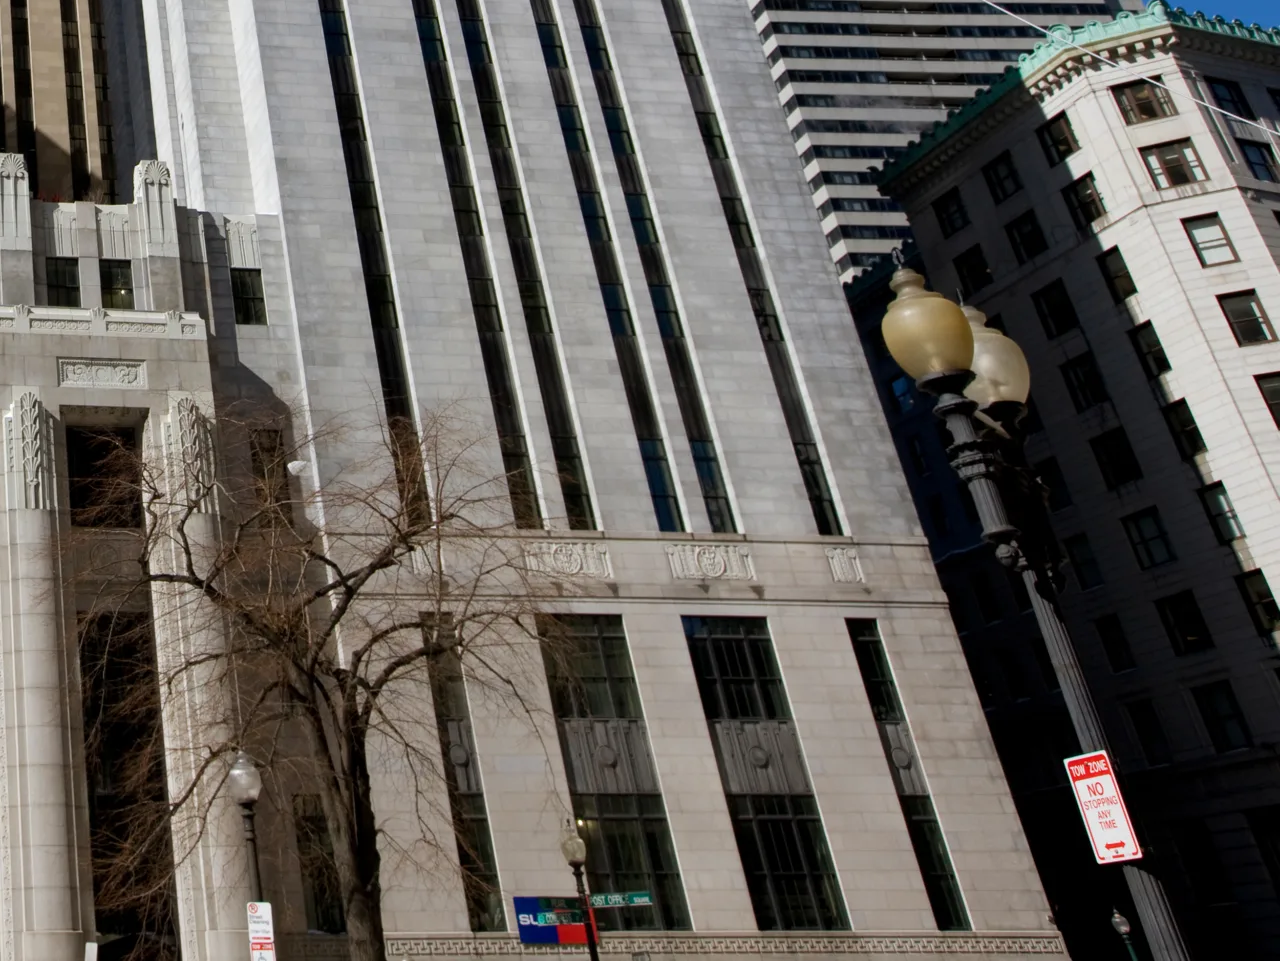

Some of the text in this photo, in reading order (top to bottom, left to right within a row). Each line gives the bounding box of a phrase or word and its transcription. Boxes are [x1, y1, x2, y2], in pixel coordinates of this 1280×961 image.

[1070, 760, 1108, 777] TOW ZONE
[1087, 782, 1104, 797] NO
[1083, 796, 1118, 810] STOPPING
[1097, 809, 1111, 820] ANY
[1099, 819, 1118, 830] TIME
